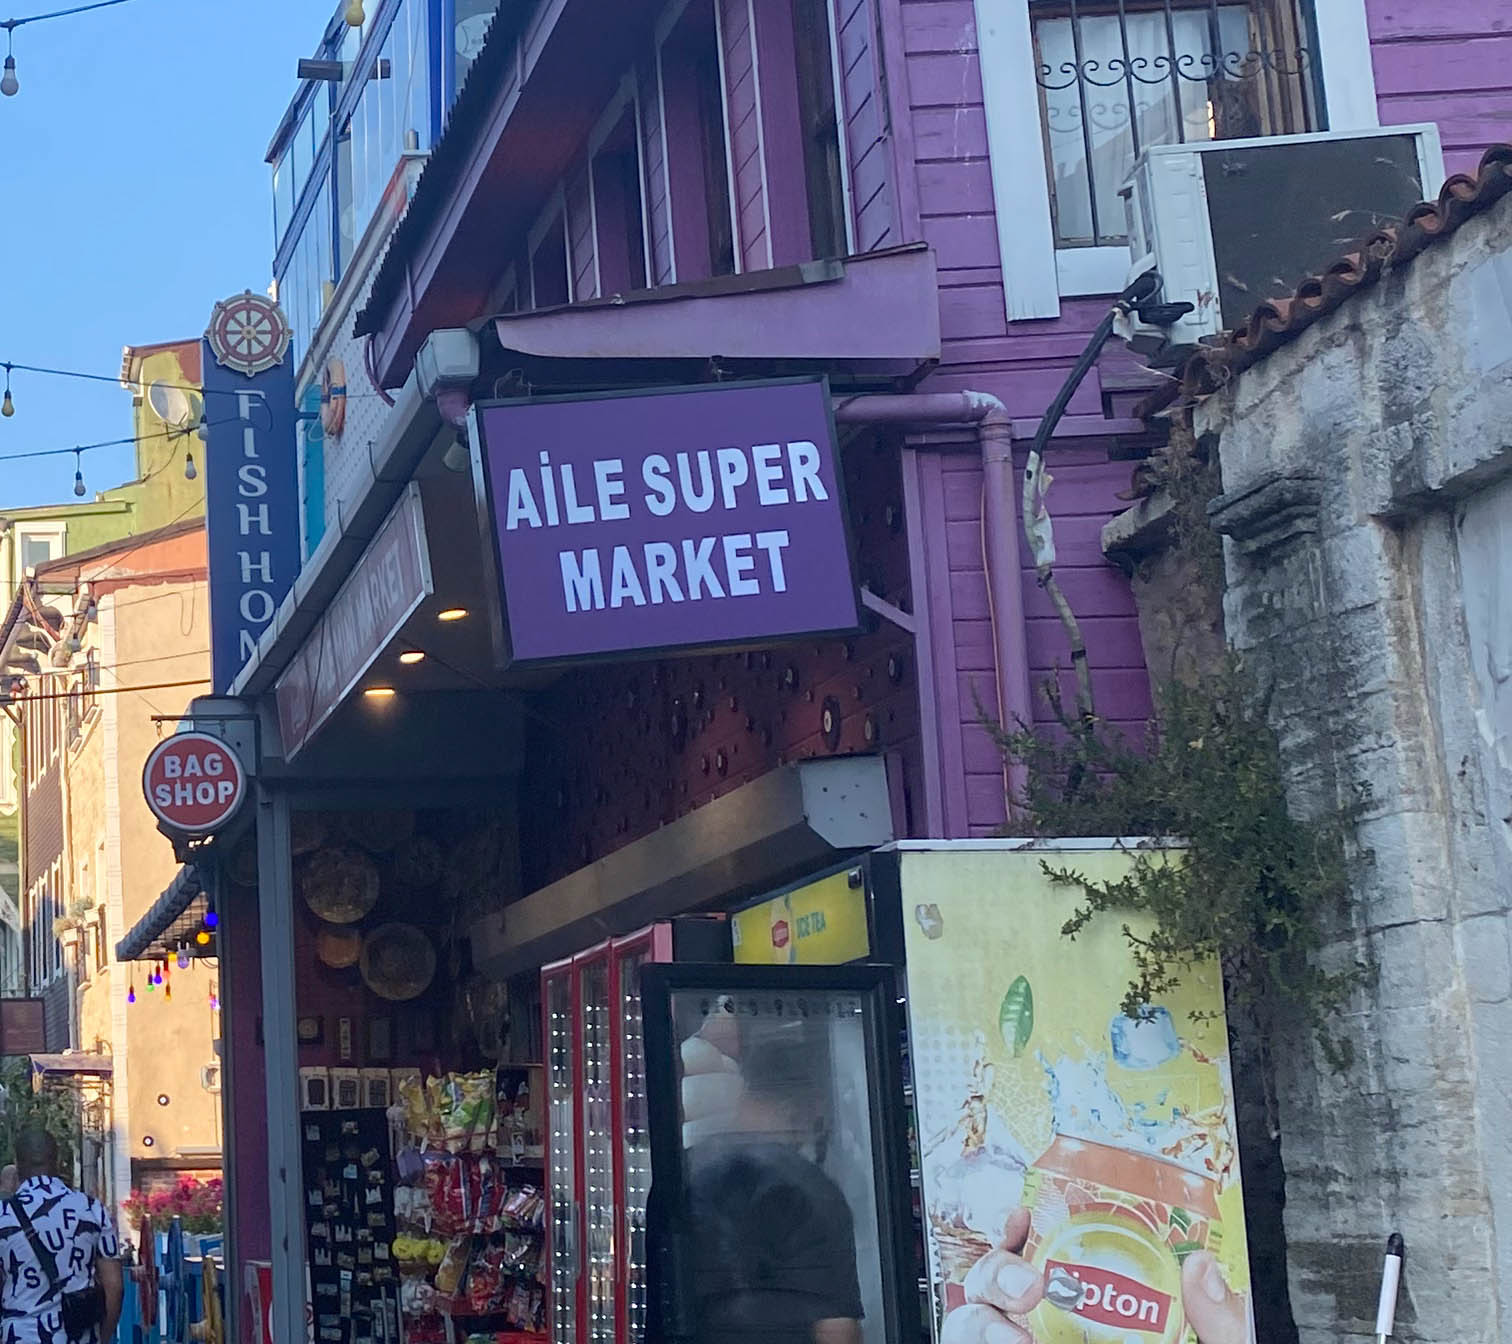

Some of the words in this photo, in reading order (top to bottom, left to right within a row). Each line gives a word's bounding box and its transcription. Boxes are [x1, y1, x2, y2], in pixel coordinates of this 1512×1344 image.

[234, 389, 272, 536] FISH
[505, 451, 630, 530] AİLE
[641, 441, 829, 516] SUPER
[559, 530, 790, 613] MARKET
[155, 781, 234, 806] SHOP
[164, 753, 223, 778] BAG
[1049, 1267, 1159, 1324] pton
